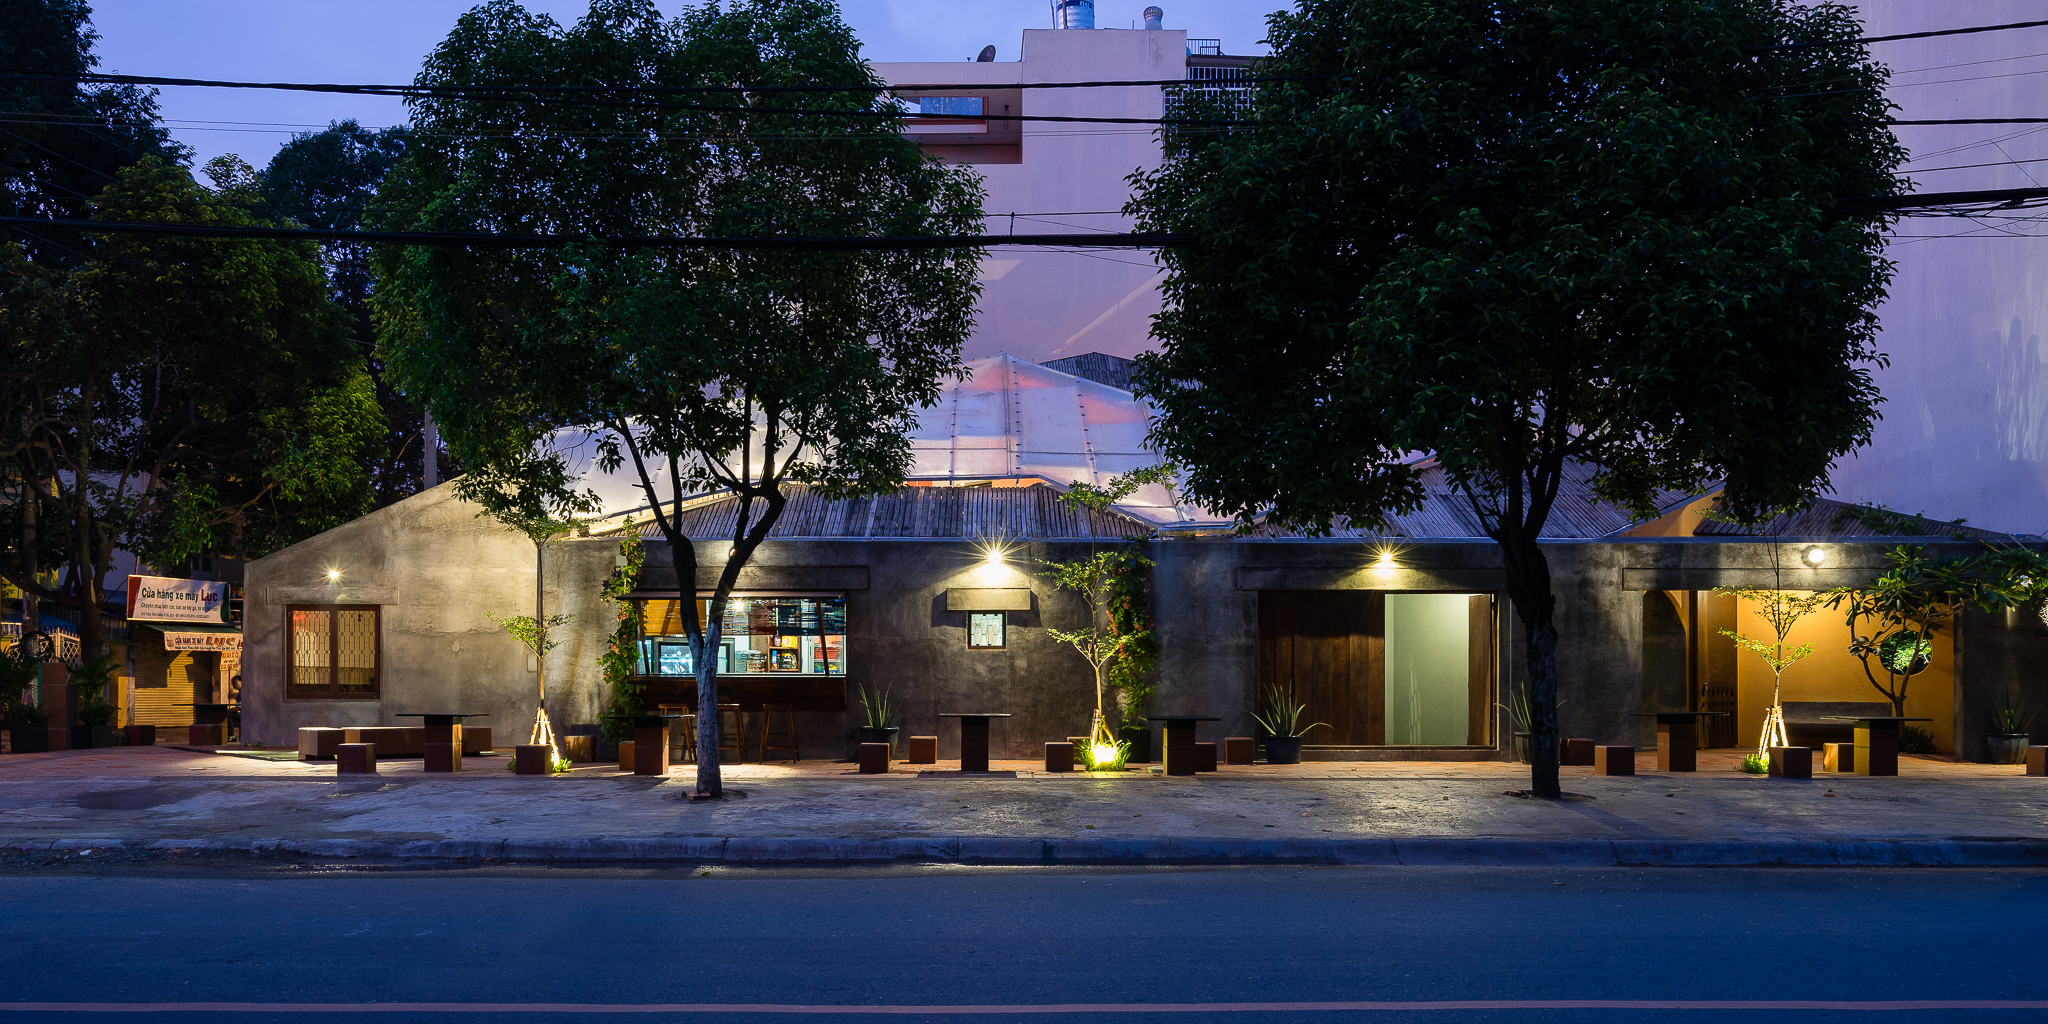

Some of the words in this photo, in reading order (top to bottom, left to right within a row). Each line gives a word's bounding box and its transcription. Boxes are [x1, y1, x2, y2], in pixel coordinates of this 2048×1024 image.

[142, 587, 155, 599] Cửa
[157, 589, 174, 602] hàng
[176, 592, 183, 600] xe
[186, 591, 199, 603] máy
[201, 589, 219, 605] Lục
